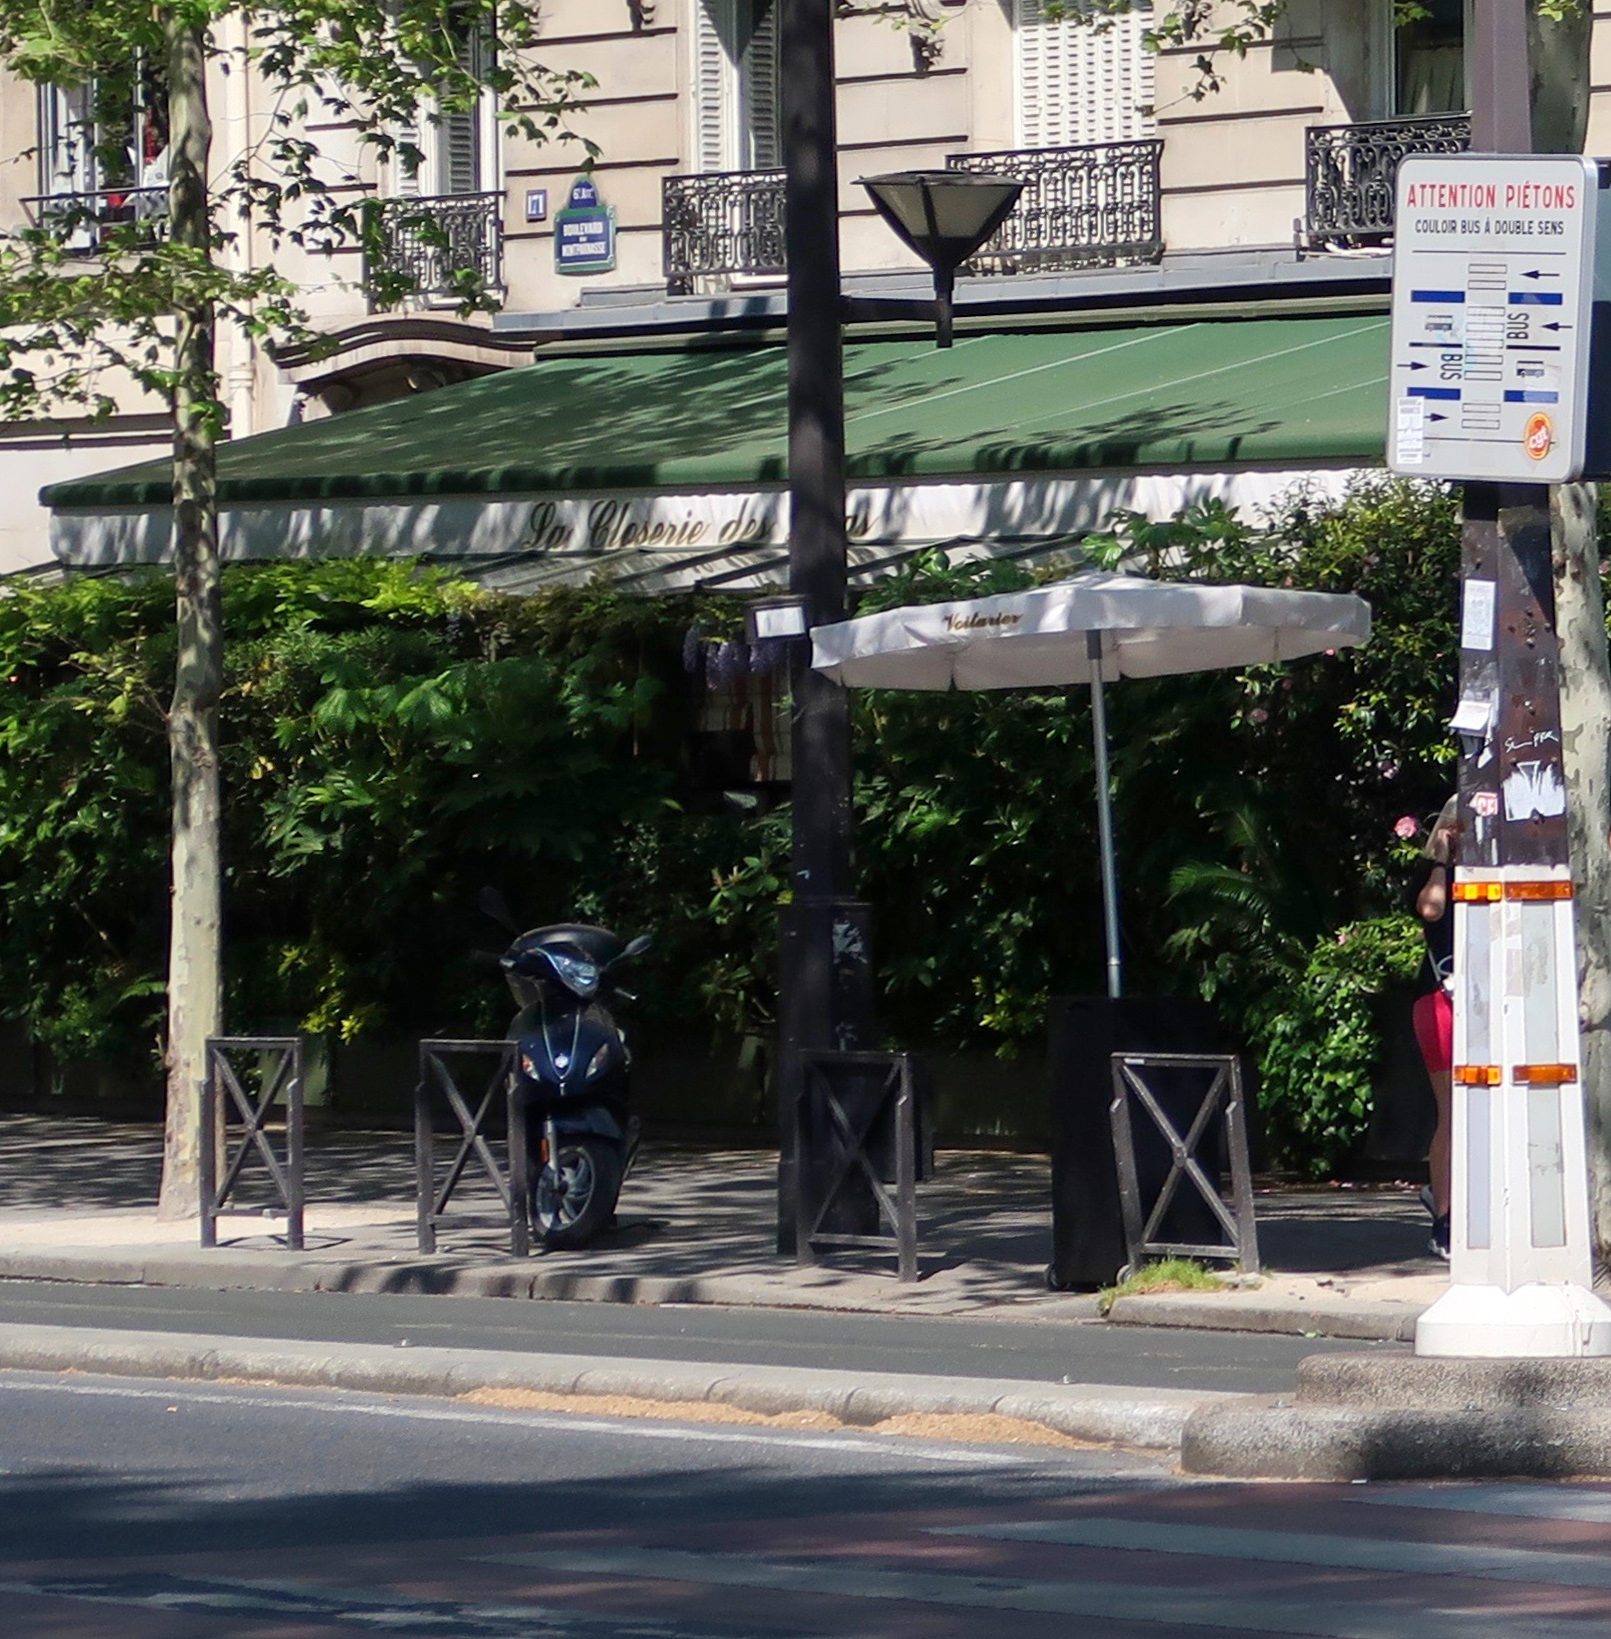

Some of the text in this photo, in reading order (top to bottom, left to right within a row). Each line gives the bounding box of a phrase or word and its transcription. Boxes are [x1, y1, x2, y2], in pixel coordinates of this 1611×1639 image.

[1407, 180, 1575, 209] ATTENTION PIÉTONS
[1415, 219, 1457, 234] COULOIR
[1461, 220, 1480, 234] BUS
[1495, 220, 1534, 235] DOUBLE
[1537, 220, 1565, 235] SENS
[1506, 312, 1530, 340] BUS
[1440, 353, 1463, 381] BUS
[1528, 425, 1549, 450] cgt
[521, 497, 777, 551] La Closerie des
